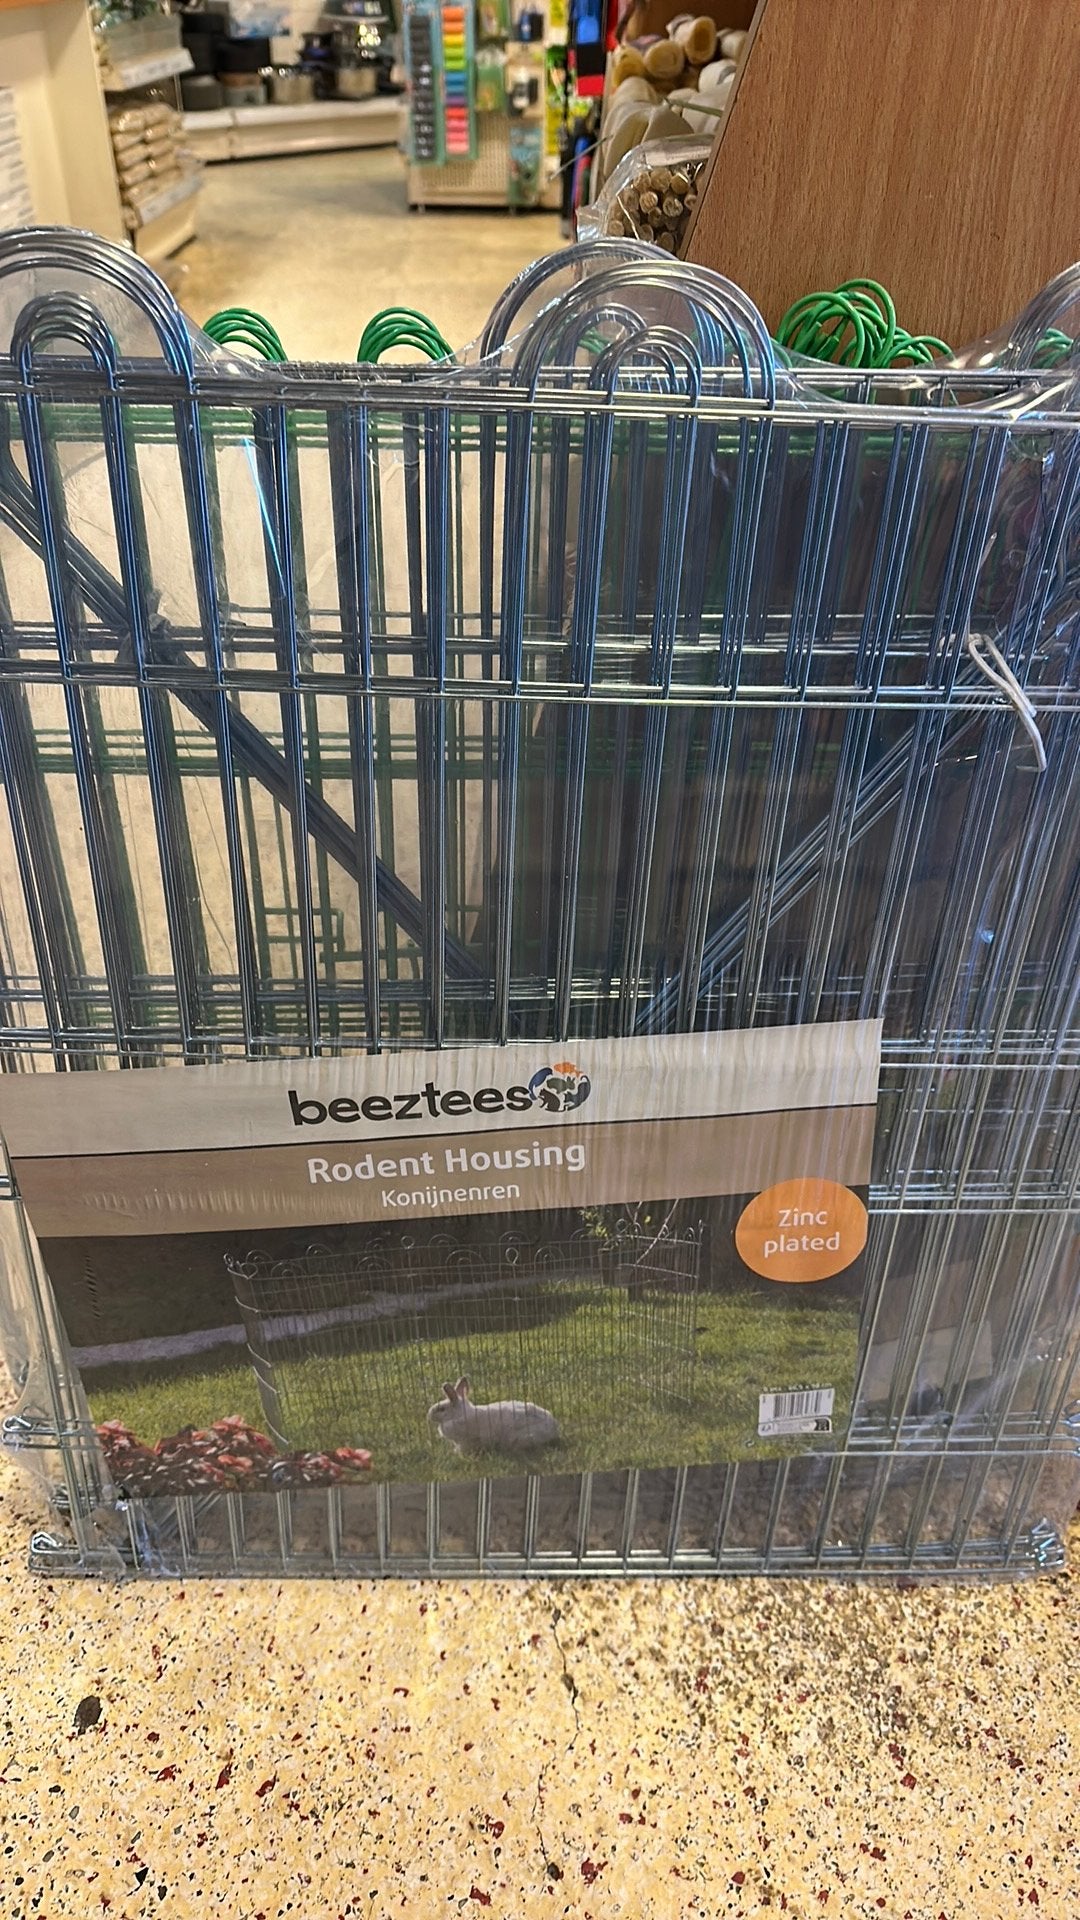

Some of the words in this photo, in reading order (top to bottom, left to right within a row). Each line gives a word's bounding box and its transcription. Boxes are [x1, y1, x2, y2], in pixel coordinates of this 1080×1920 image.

[287, 1082, 533, 1126] beeztees
[307, 1153, 435, 1184] Rodent
[445, 1141, 586, 1174] Housing
[381, 1184, 520, 1208] Konijnenren
[778, 1207, 828, 1227] Zinc
[764, 1231, 840, 1259] plated
